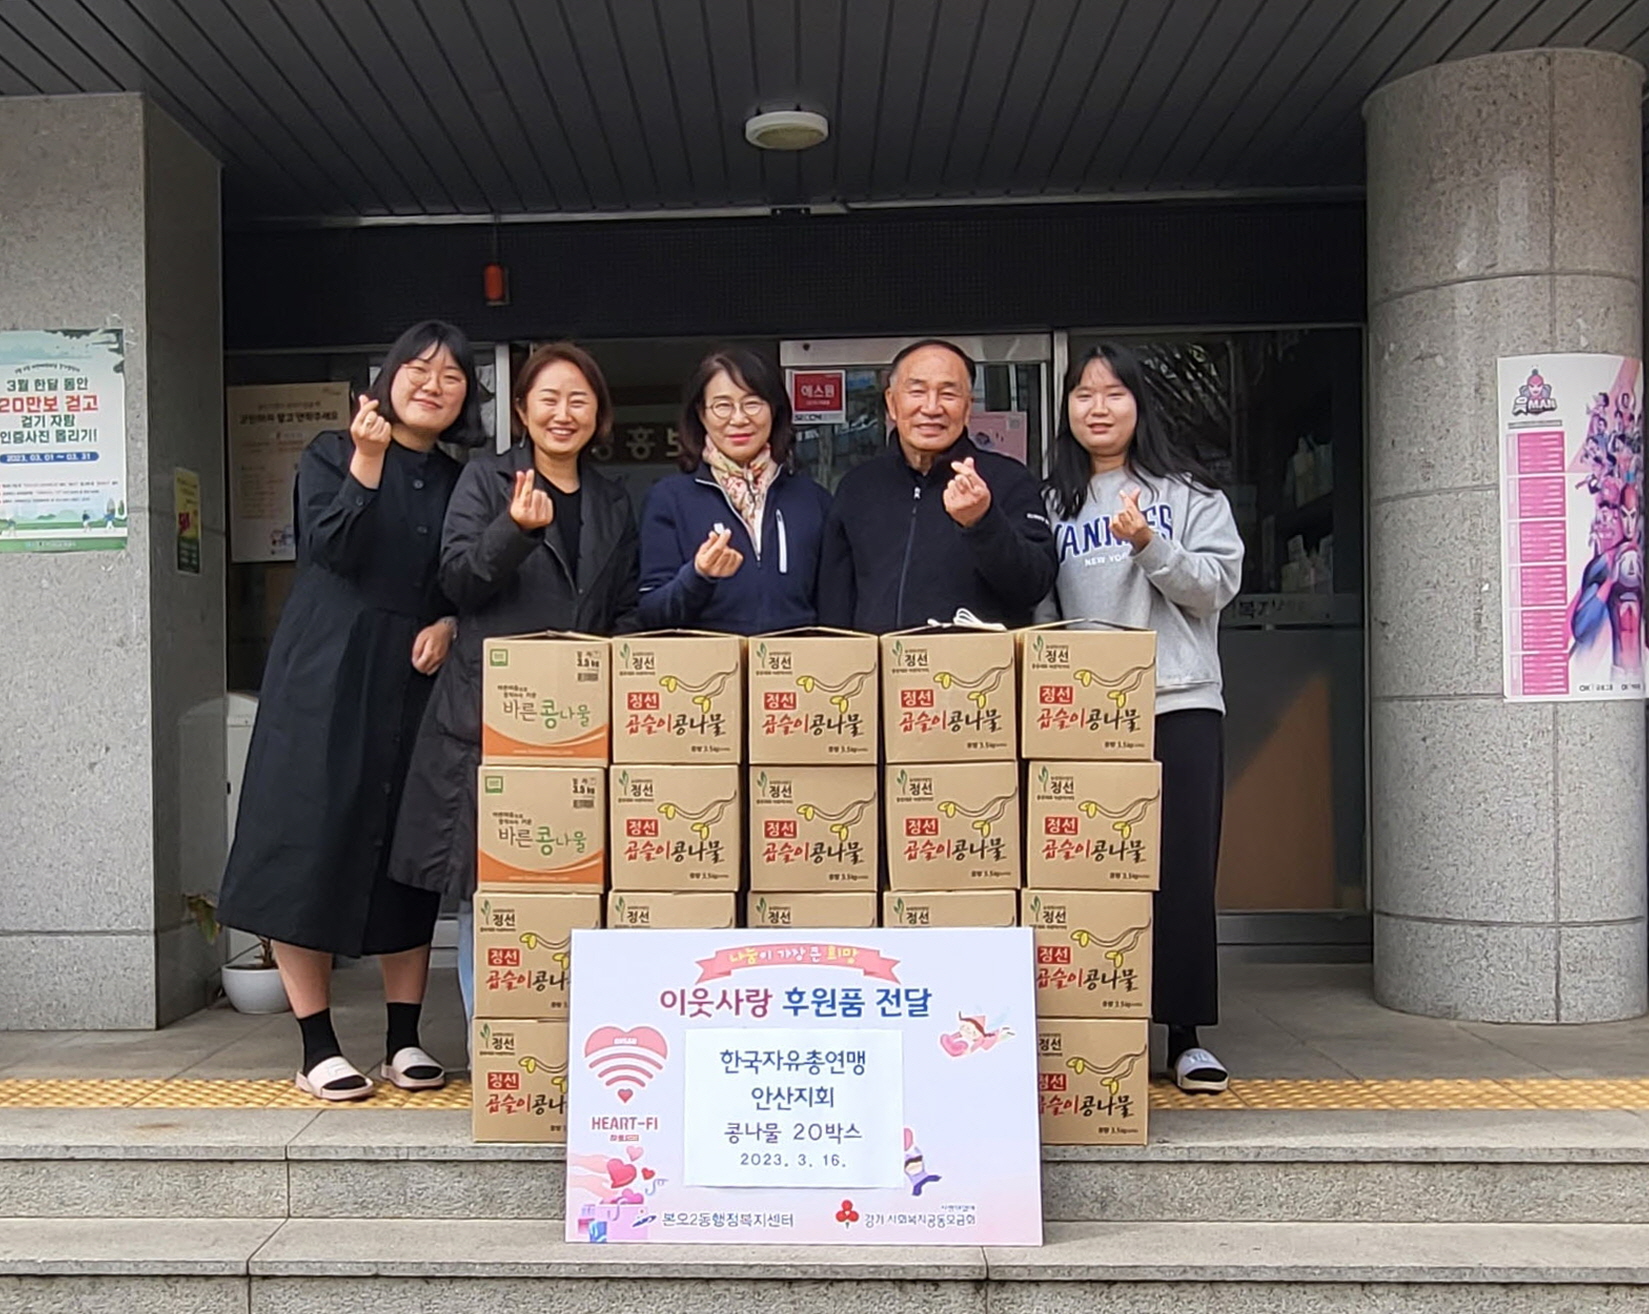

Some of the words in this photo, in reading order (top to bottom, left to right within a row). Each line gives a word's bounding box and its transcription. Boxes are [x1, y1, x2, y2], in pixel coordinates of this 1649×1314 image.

[7, 379, 29, 392] 3월
[35, 379, 59, 391] 한달
[64, 377, 88, 391] 동안
[0, 396, 59, 413] 20만보
[65, 395, 98, 412] 걷고
[0, 430, 49, 444] 인증사진
[1085, 556, 1105, 566] NEW
[632, 657, 654, 669] 정선
[769, 657, 791, 669] 정선
[905, 654, 927, 666] 정선
[1046, 650, 1068, 662] 정선
[630, 694, 657, 708] 정선
[767, 694, 794, 708] 정선
[904, 691, 931, 705] 정선
[1043, 688, 1070, 702] 정선
[631, 784, 653, 796] 정선
[769, 786, 791, 798] 정선
[910, 783, 932, 795] 정선
[1051, 782, 1073, 794] 정선
[629, 821, 656, 835] 정선
[767, 822, 794, 836] 정선
[909, 820, 936, 834] 정선
[1048, 819, 1075, 833] 정선
[493, 914, 515, 926] 정선
[627, 911, 649, 923] 정선
[768, 912, 790, 924] 정선
[907, 912, 929, 924] 정선
[1043, 911, 1065, 923] 정선
[491, 950, 518, 964] 정선
[729, 947, 772, 964] 나눔이
[777, 948, 806, 961] 가장
[810, 946, 821, 963] 큰
[827, 945, 859, 965] 희망
[1041, 948, 1068, 962] 정선
[486, 970, 570, 992] 곱슬이콩나
[660, 988, 773, 1018] 이웃사랑
[783, 987, 865, 1018] 후원품
[876, 988, 932, 1018] 전달
[492, 1038, 514, 1050] 정선
[1039, 1038, 1061, 1050] 정선
[720, 1050, 866, 1076] 한국자유총연맹
[490, 1074, 517, 1088] 정선
[485, 1094, 567, 1115] 곱슬이콩나
[751, 1087, 834, 1111] 안산지회
[592, 1117, 658, 1130] HEART-FI
[724, 1122, 782, 1144] 콩나물
[793, 1123, 863, 1145] 20박스
[740, 1153, 789, 1167] 2023.
[798, 1154, 813, 1167] 3.
[823, 1154, 846, 1167] 16.
[662, 1212, 794, 1228] 본오2동행정복지센터
